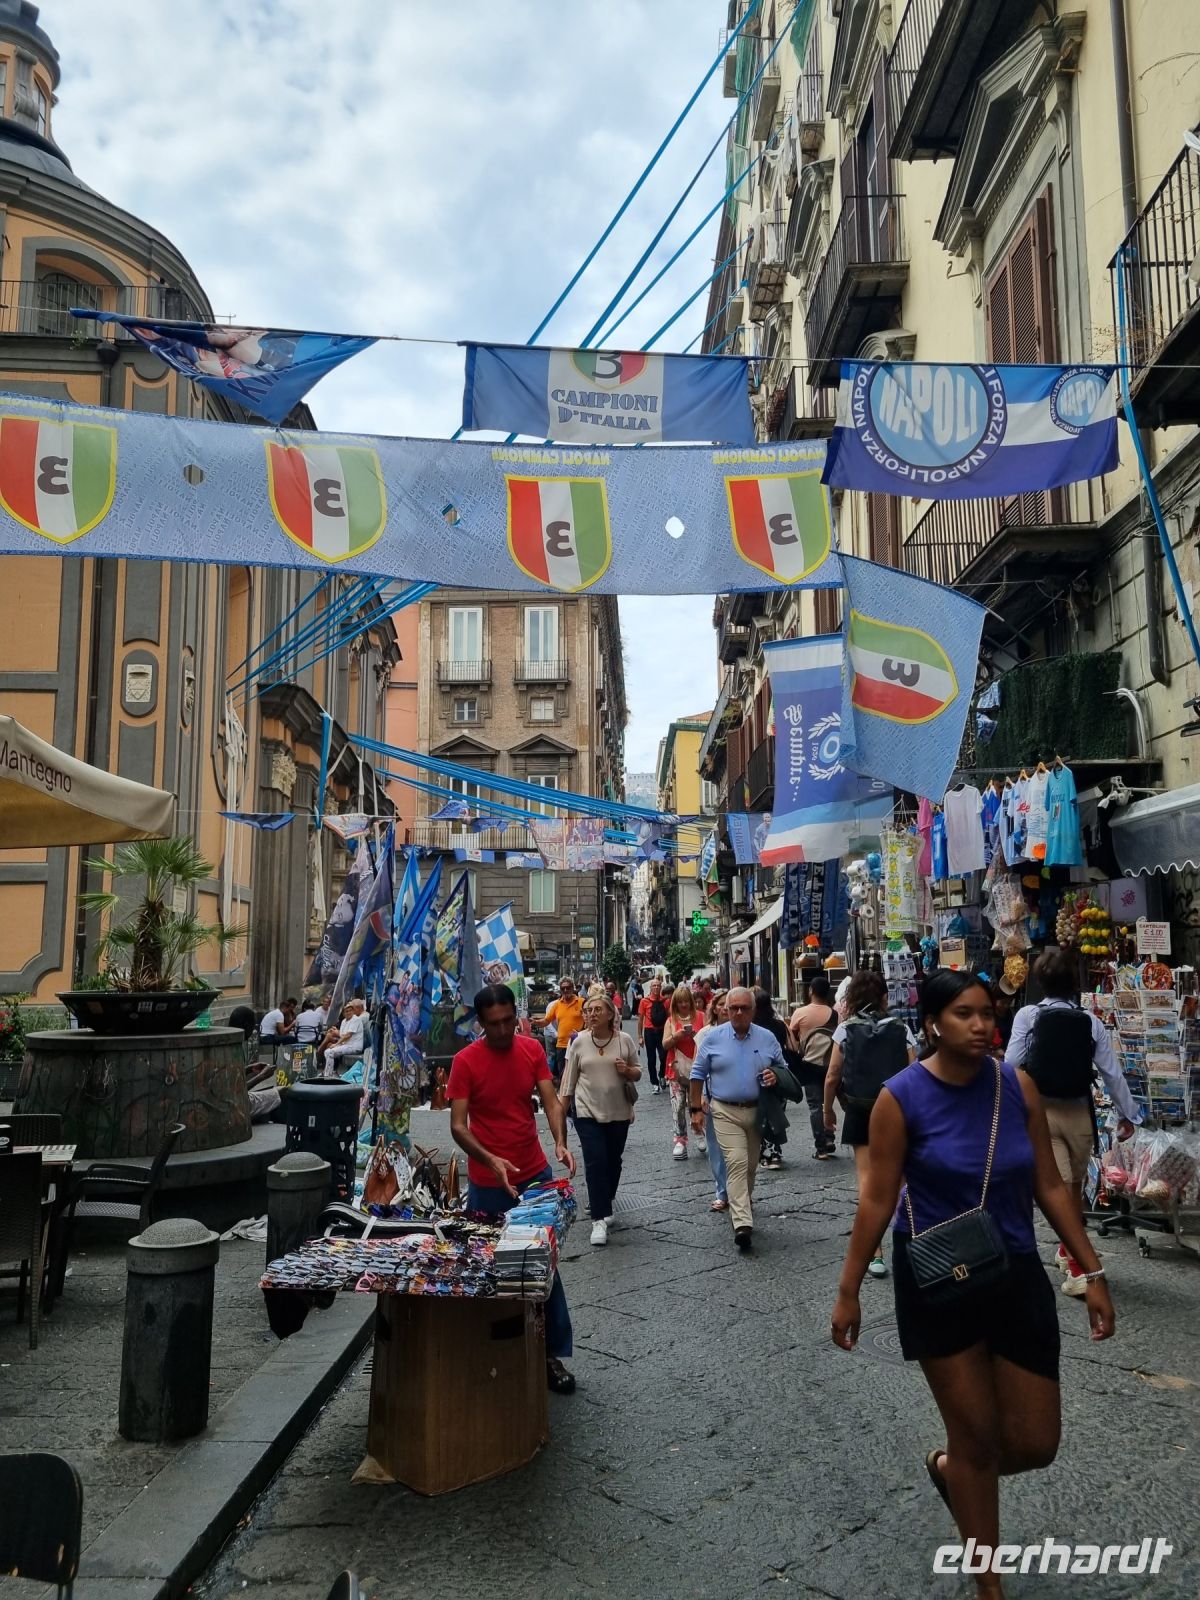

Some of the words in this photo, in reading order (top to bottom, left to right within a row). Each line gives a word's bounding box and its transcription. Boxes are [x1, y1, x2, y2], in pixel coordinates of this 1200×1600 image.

[551, 389, 658, 413] CAMPIONI
[879, 365, 977, 446] NAPOLI
[558, 405, 651, 430] D'ITALIA
